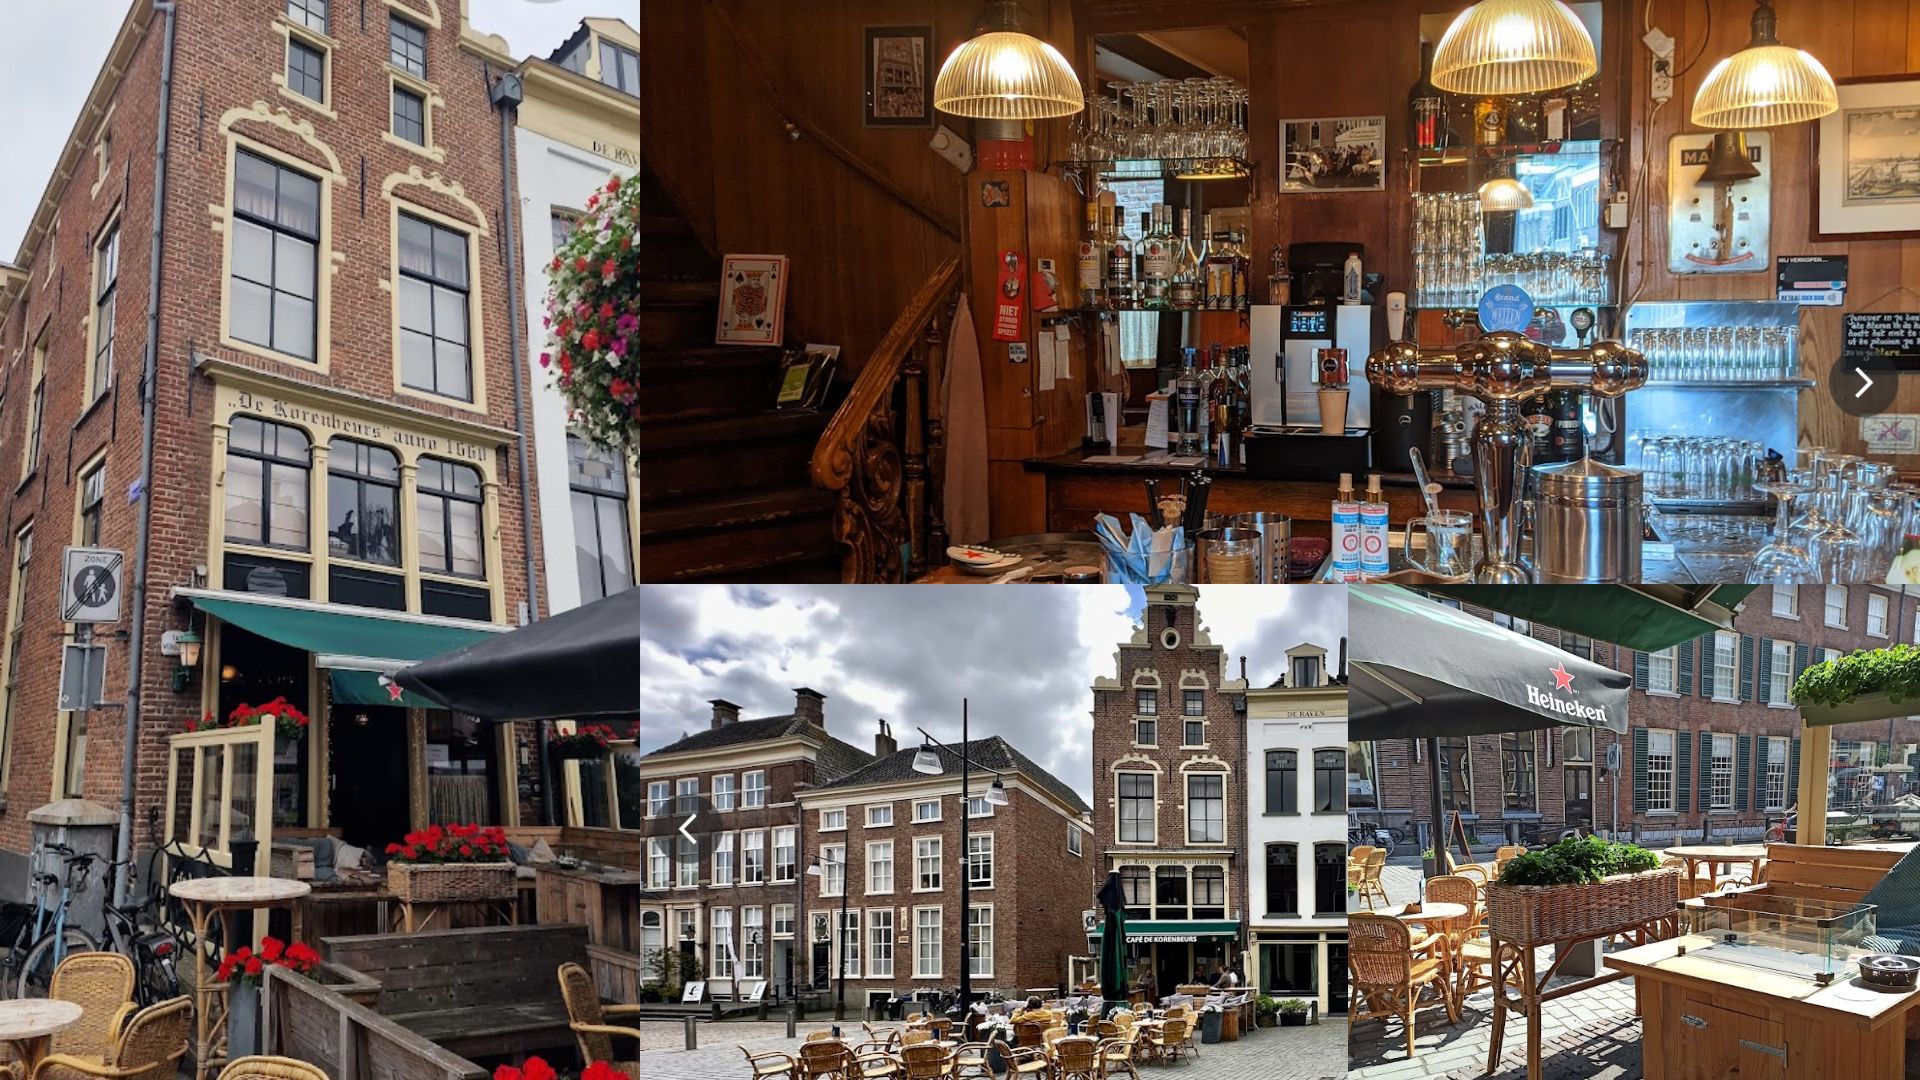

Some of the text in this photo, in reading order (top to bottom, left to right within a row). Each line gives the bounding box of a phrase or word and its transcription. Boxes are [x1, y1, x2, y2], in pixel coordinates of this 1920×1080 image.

[593, 141, 606, 155] DE
[1000, 304, 1019, 317] NIET
[393, 431, 437, 450] anno
[84, 555, 108, 564] ZONE
[1526, 684, 1608, 722] Heineken
[1299, 710, 1325, 718] RAVEN
[1125, 935, 1143, 943] CAFÉ
[1153, 935, 1197, 943] KORENBEURS
